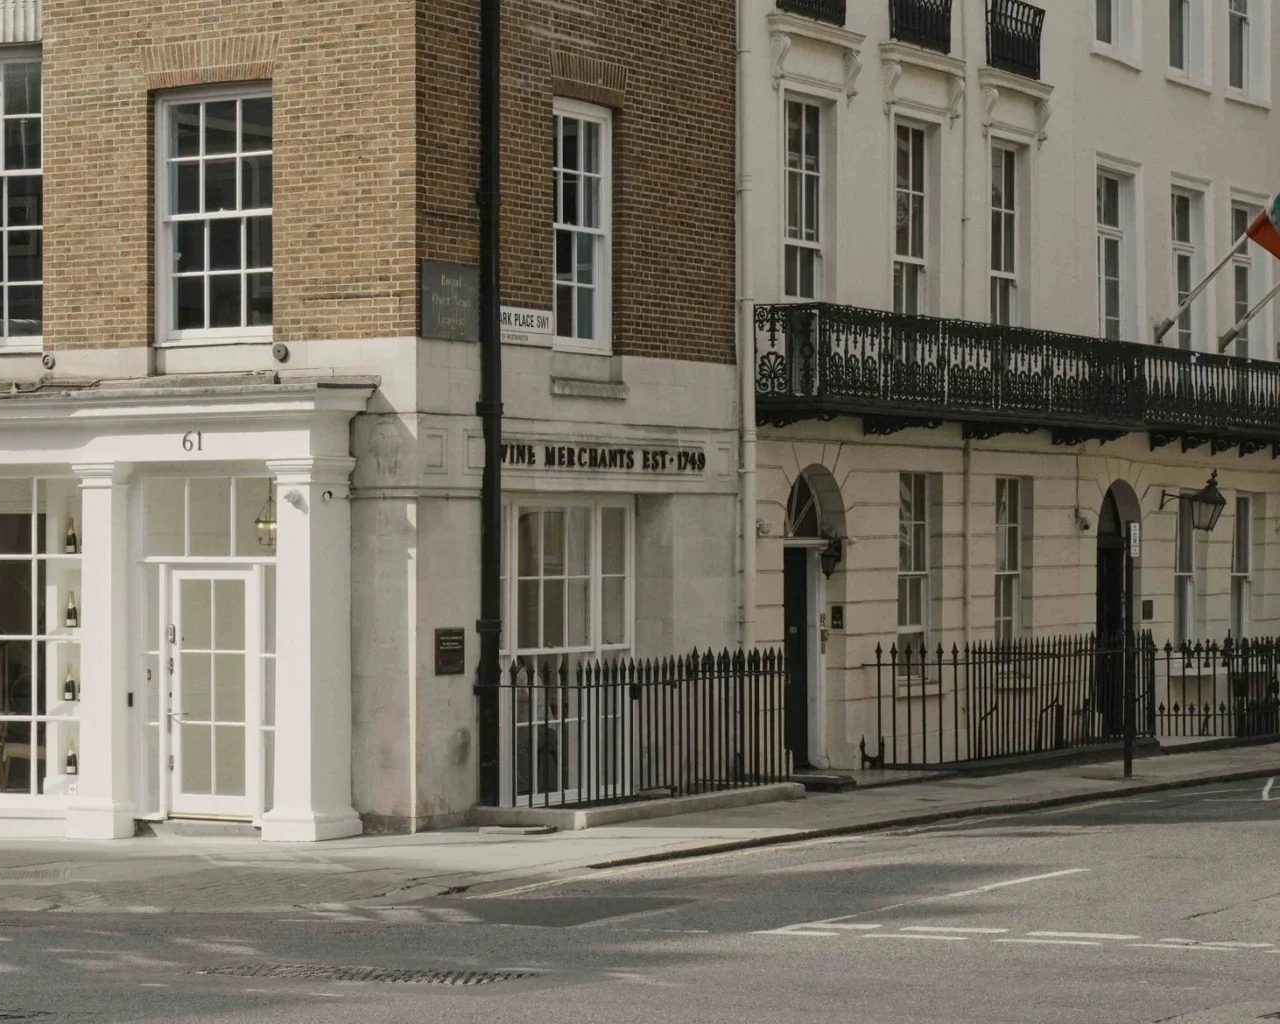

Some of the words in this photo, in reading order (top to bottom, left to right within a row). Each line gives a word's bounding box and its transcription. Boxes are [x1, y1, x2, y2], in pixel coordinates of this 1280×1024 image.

[440, 273, 462, 288] Royal
[499, 312, 513, 326] ARK
[514, 313, 535, 328] PLACE
[536, 315, 550, 329] SW1
[182, 430, 203, 452] 61
[544, 445, 635, 471] MERCHANTS
